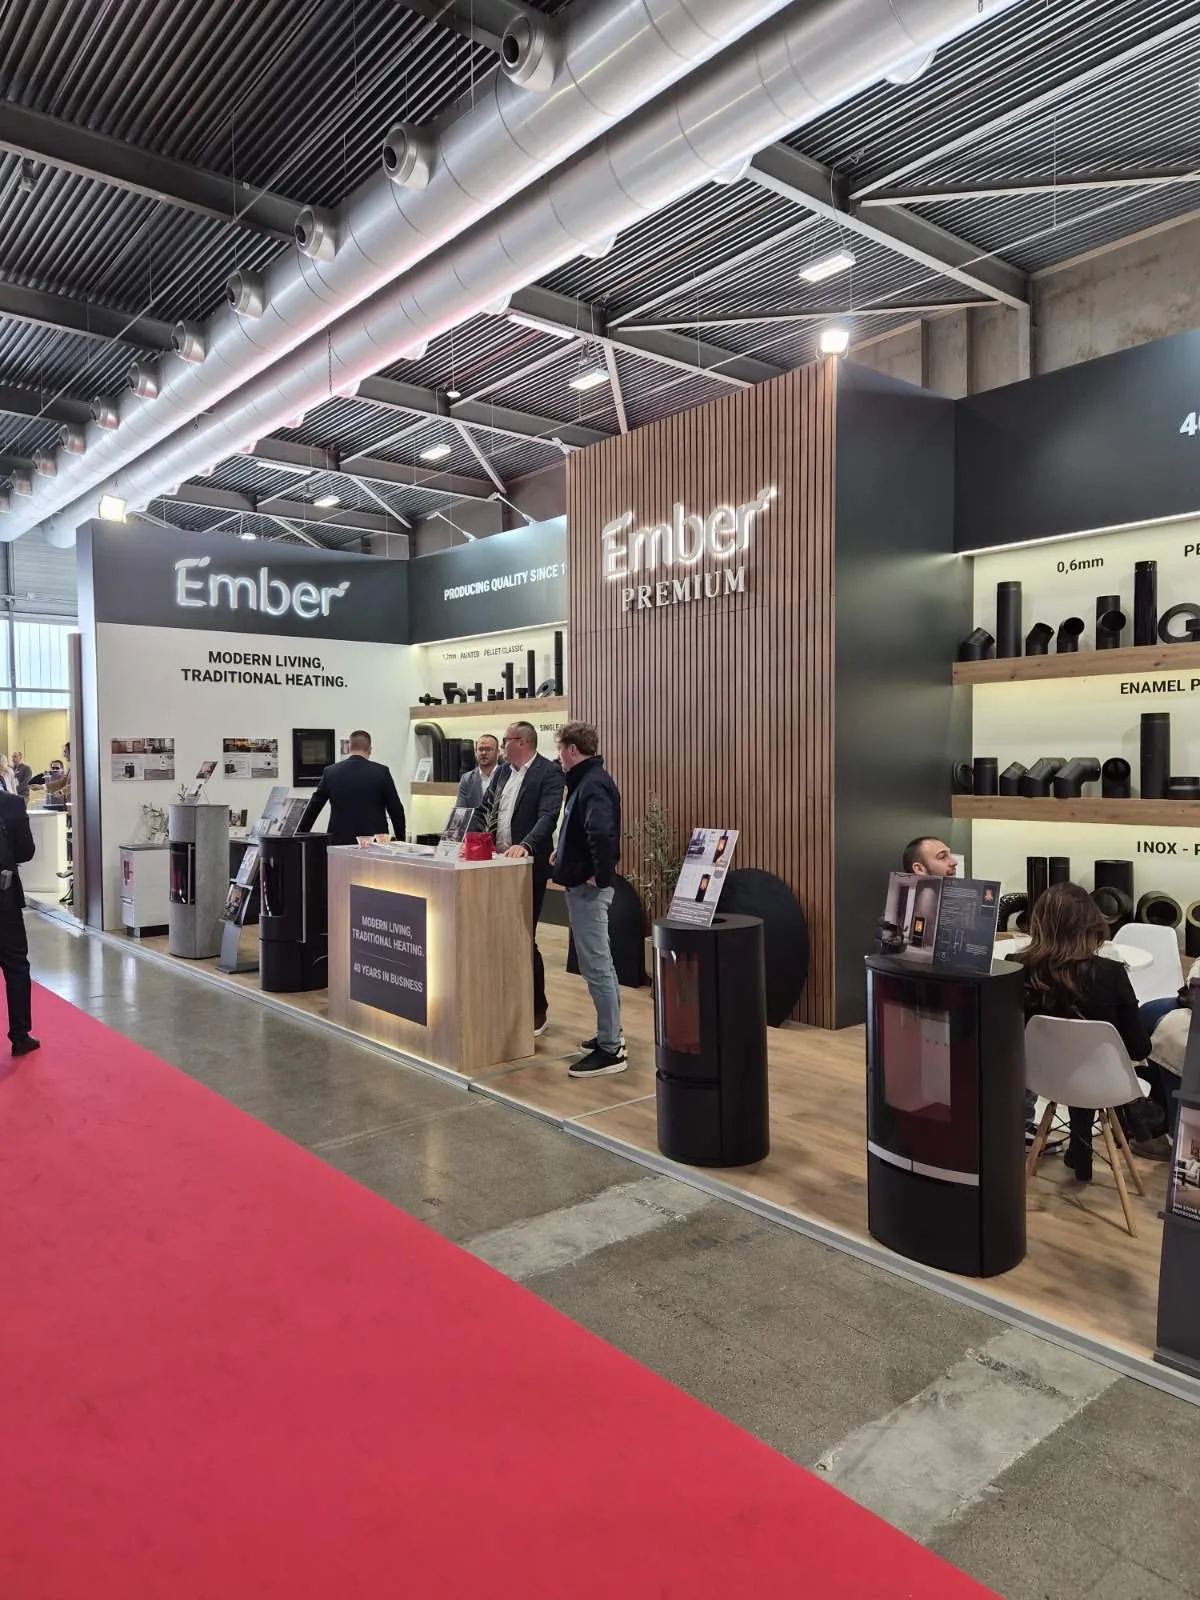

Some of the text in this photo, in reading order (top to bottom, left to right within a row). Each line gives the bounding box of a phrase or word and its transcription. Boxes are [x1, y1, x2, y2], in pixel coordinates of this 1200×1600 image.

[1180, 411, 1200, 436] 4
[601, 485, 779, 581] Ember
[1057, 557, 1104, 575] 0,6mm
[174, 555, 351, 619] Ember
[444, 580, 490, 600] PRODUCING
[491, 571, 528, 591] QUALITY
[530, 564, 559, 582] SINCE
[621, 566, 745, 612] PREMIUM
[208, 650, 325, 672] MODERN LIVING,
[181, 668, 348, 688] TRADITIONAL HEATING.
[1120, 679, 1186, 695] ENAMEL
[1137, 840, 1177, 855] INOX
[361, 916, 412, 939] MODERN LIVING,
[352, 928, 424, 957] TRADITIONAL HEATING.
[361, 963, 382, 980] YEARS
[382, 969, 390, 982] IN
[390, 973, 424, 993] BUSINESS
